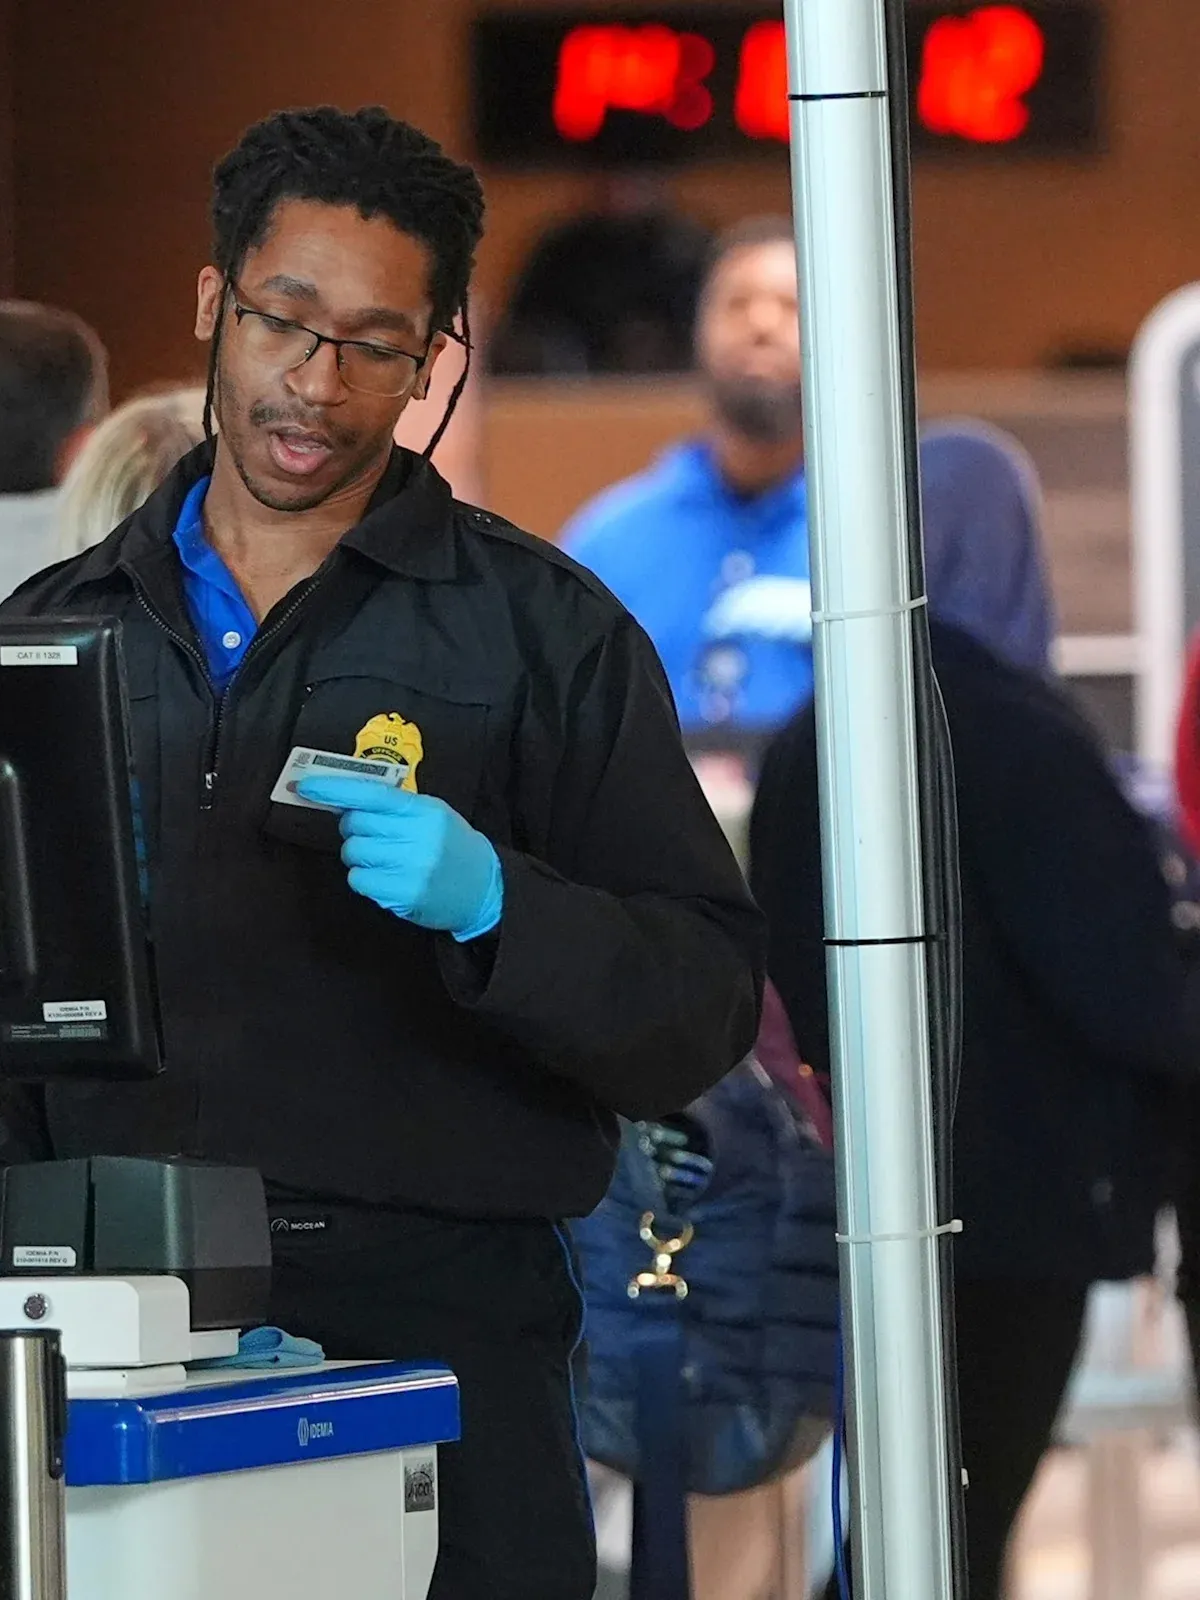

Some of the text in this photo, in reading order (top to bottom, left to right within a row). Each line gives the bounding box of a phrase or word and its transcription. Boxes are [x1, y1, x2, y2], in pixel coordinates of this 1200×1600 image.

[17, 651, 33, 660] CAT
[384, 735, 398, 746] US
[290, 1221, 326, 1230] MOCEAN
[310, 1421, 334, 1439] IDEMIA
